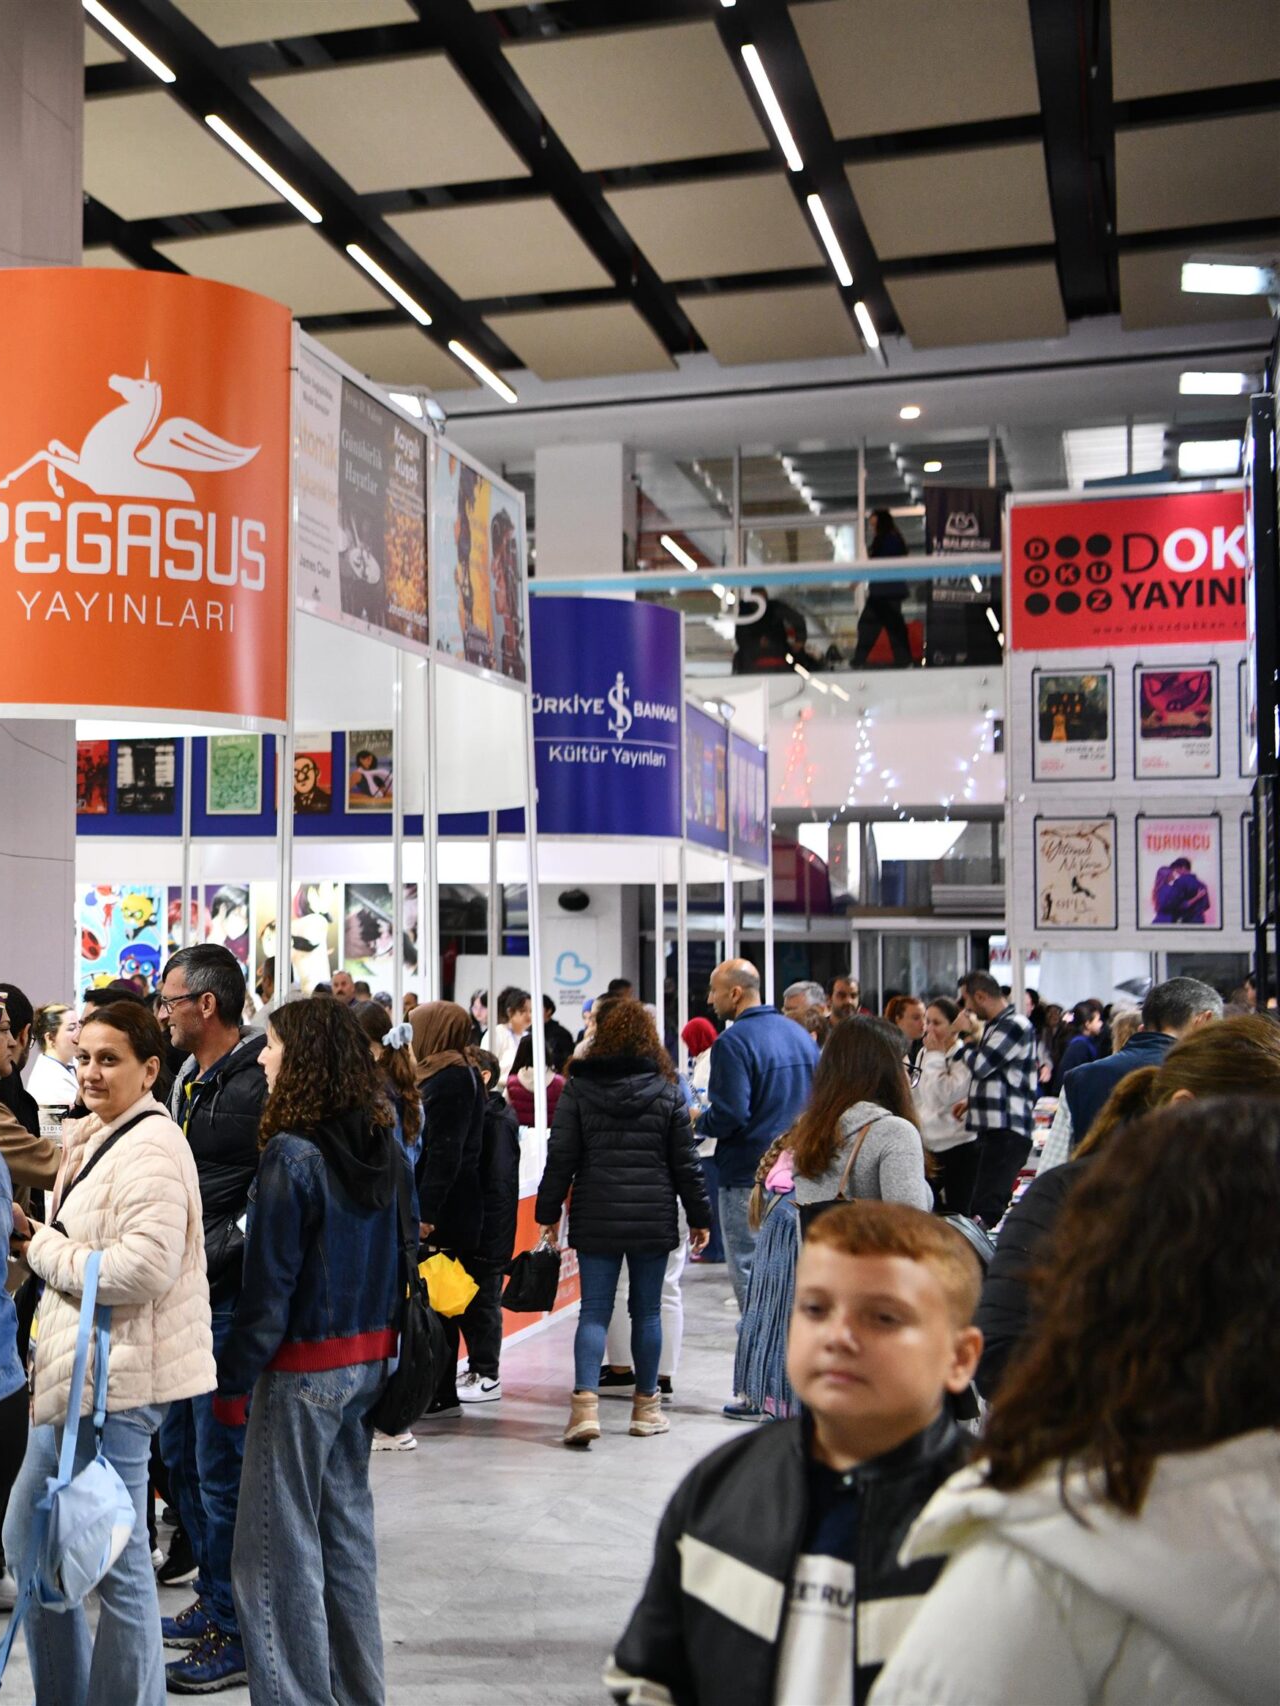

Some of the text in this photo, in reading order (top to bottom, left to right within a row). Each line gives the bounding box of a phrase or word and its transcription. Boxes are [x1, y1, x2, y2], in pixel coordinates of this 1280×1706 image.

[16, 590, 234, 632] YAYINLARI
[633, 700, 678, 723] BANKASI
[549, 744, 666, 768] Kültür Yayınları
[1146, 834, 1211, 852] TURUNCU
